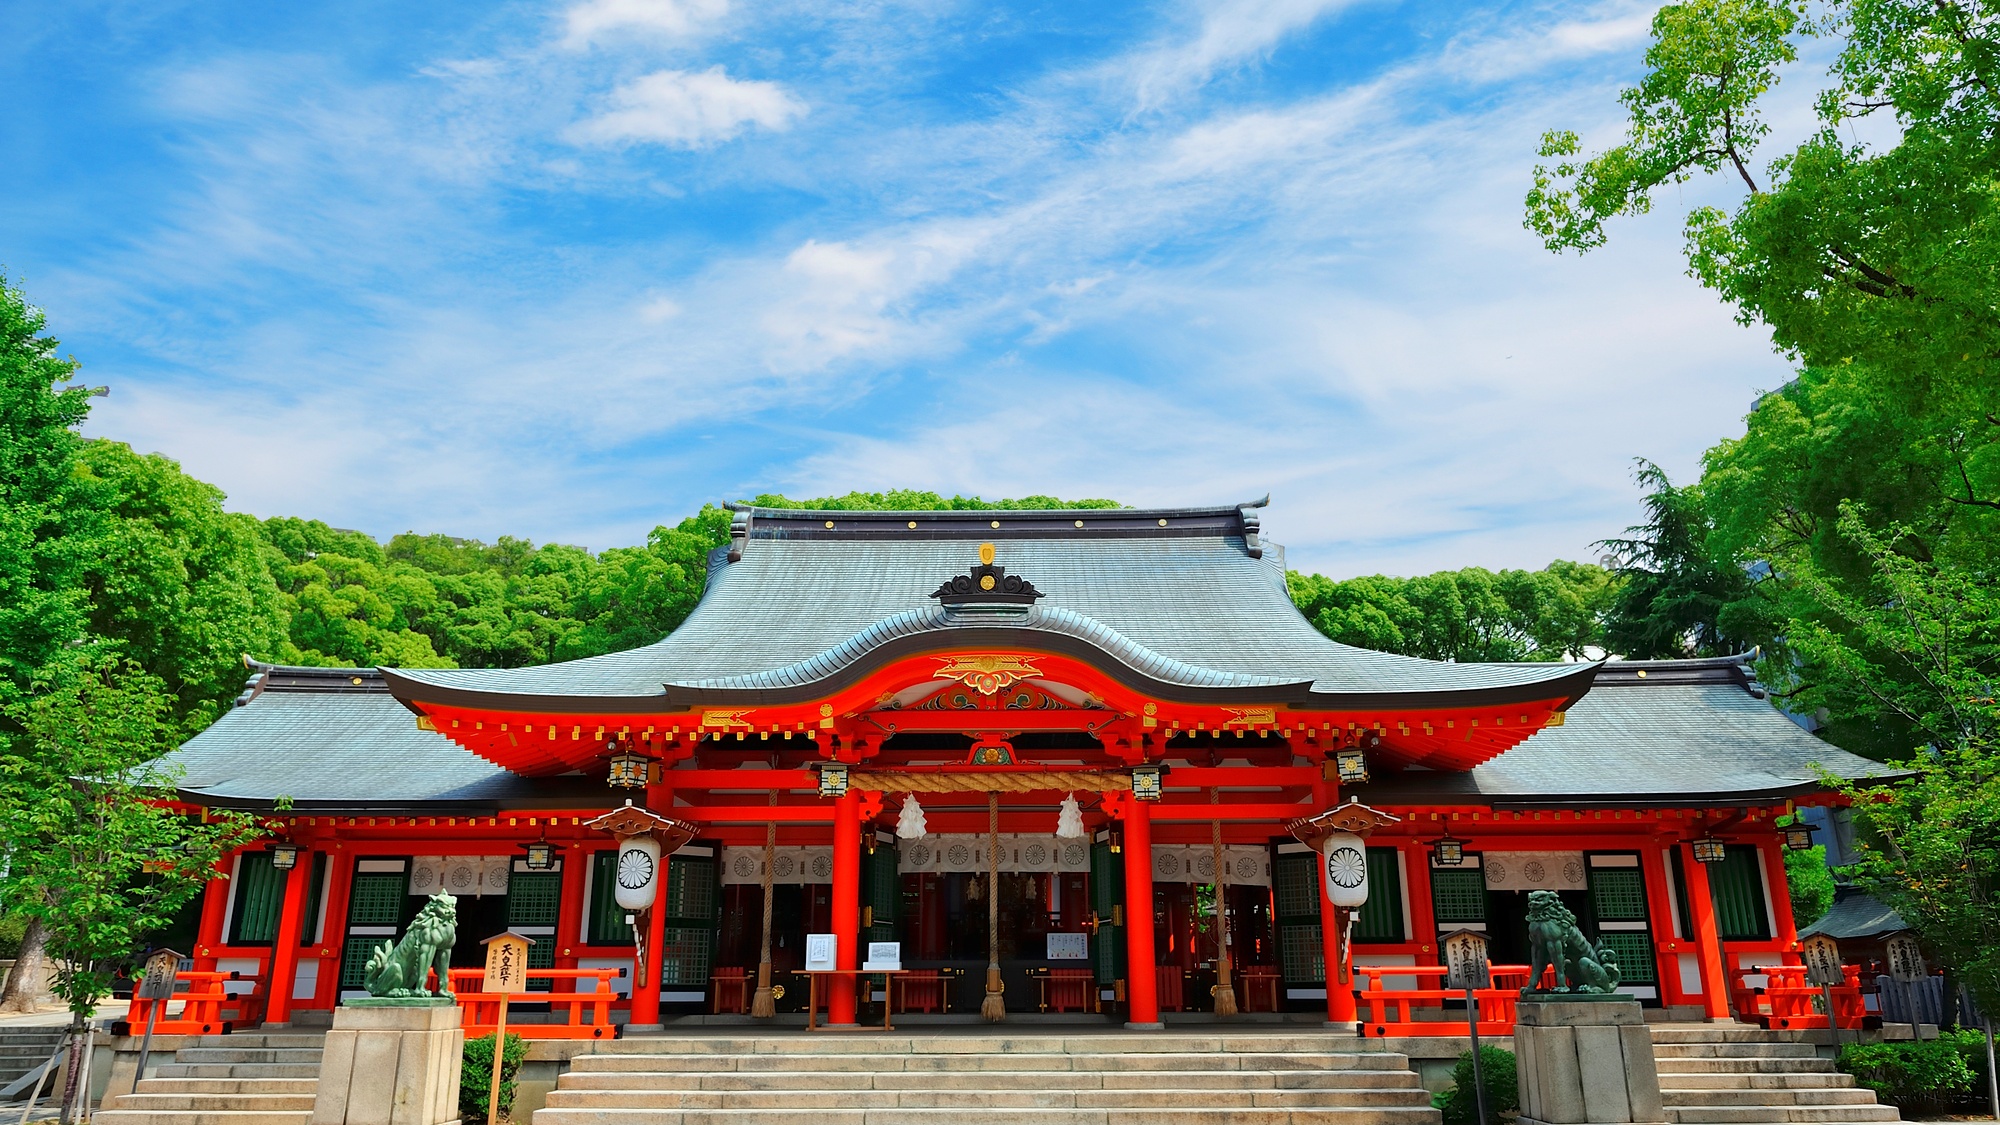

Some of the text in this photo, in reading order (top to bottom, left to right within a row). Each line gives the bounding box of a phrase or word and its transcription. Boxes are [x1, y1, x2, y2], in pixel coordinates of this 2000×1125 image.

[499, 943, 514, 986] 天皇陛下
[1460, 938, 1475, 984] 天皇陛下
[1815, 940, 1830, 974] 天皇陛下
[1898, 939, 1912, 978] 天皇陛下
